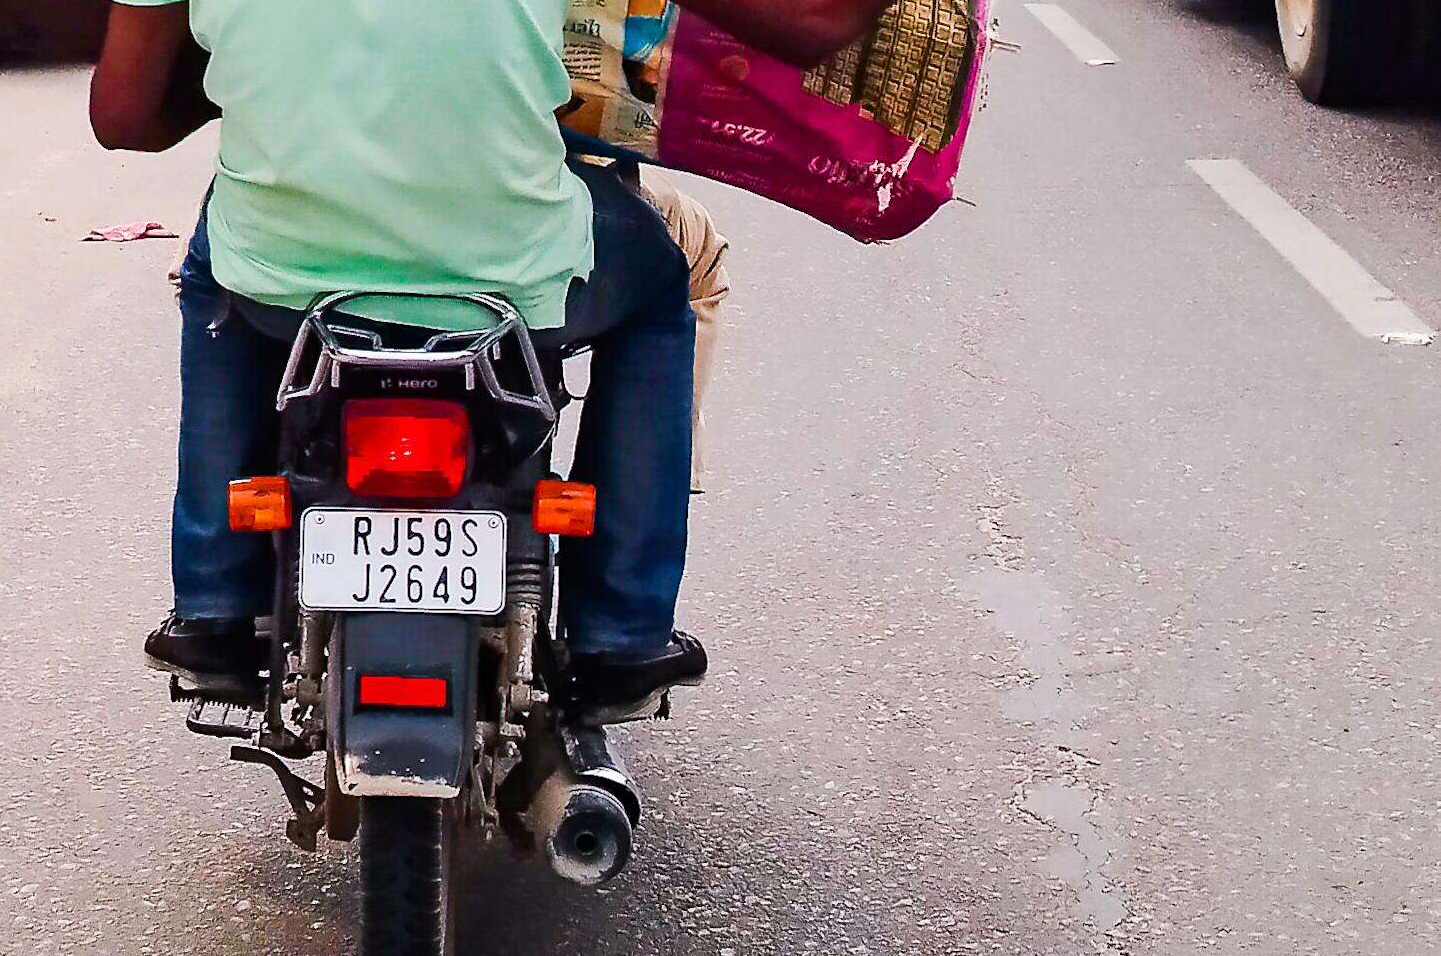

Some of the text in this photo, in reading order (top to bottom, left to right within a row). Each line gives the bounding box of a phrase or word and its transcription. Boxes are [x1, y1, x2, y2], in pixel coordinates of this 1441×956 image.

[399, 379, 438, 389] Hero
[353, 516, 479, 558] RJ59S
[311, 552, 335, 565] IND
[352, 564, 478, 605] J2649
